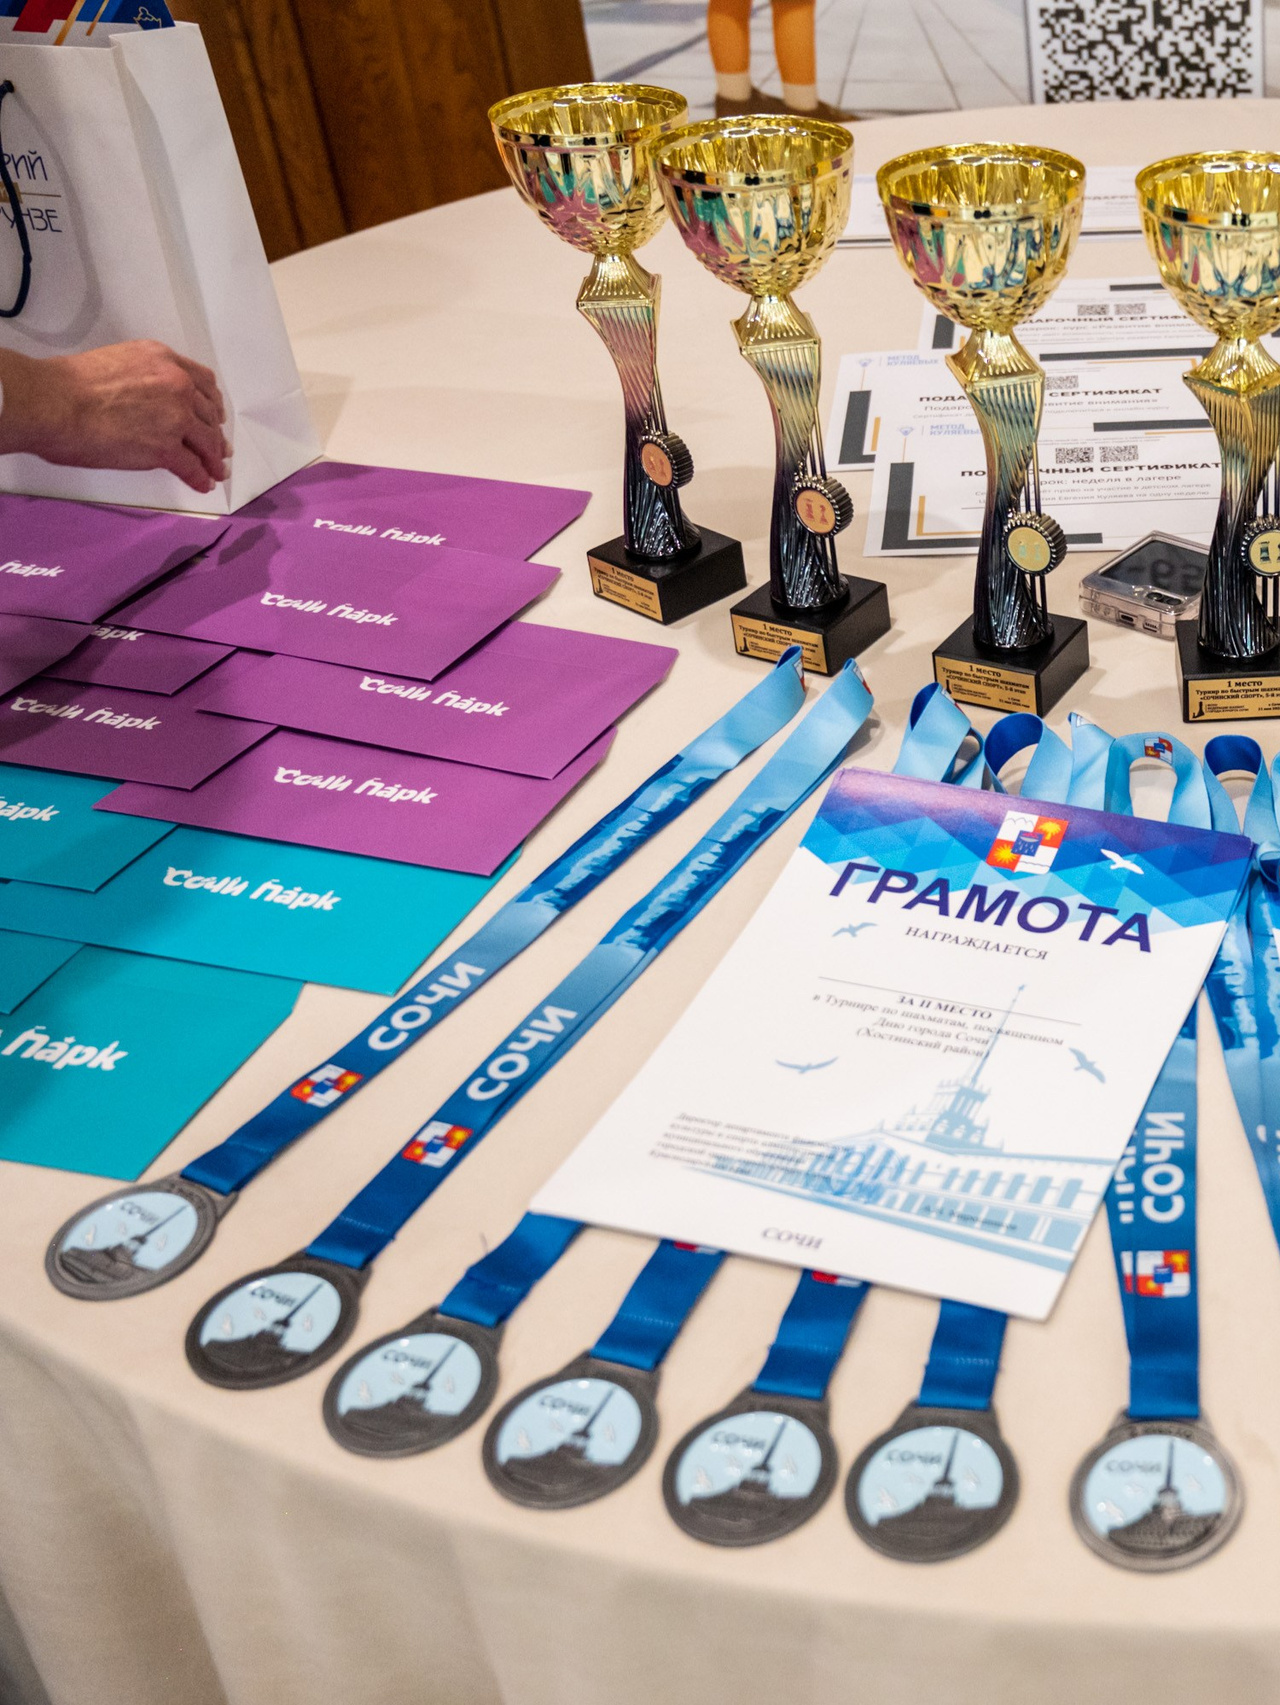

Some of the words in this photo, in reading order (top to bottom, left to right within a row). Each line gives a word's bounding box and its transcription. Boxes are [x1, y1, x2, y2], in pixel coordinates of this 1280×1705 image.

[1049, 388, 1163, 398] СЕРТИФИКАТ
[829, 862, 1152, 953] ГРАМОТА
[905, 927, 1048, 961] НАГРАЖДАЕТСЯ
[367, 961, 485, 1052] СОЧИ
[935, 1001, 992, 1020] МЕСТО
[467, 1006, 577, 1101] СОЧИ
[1141, 1112, 1185, 1223] СОЧИ
[761, 1226, 824, 1251] СОЧИ
